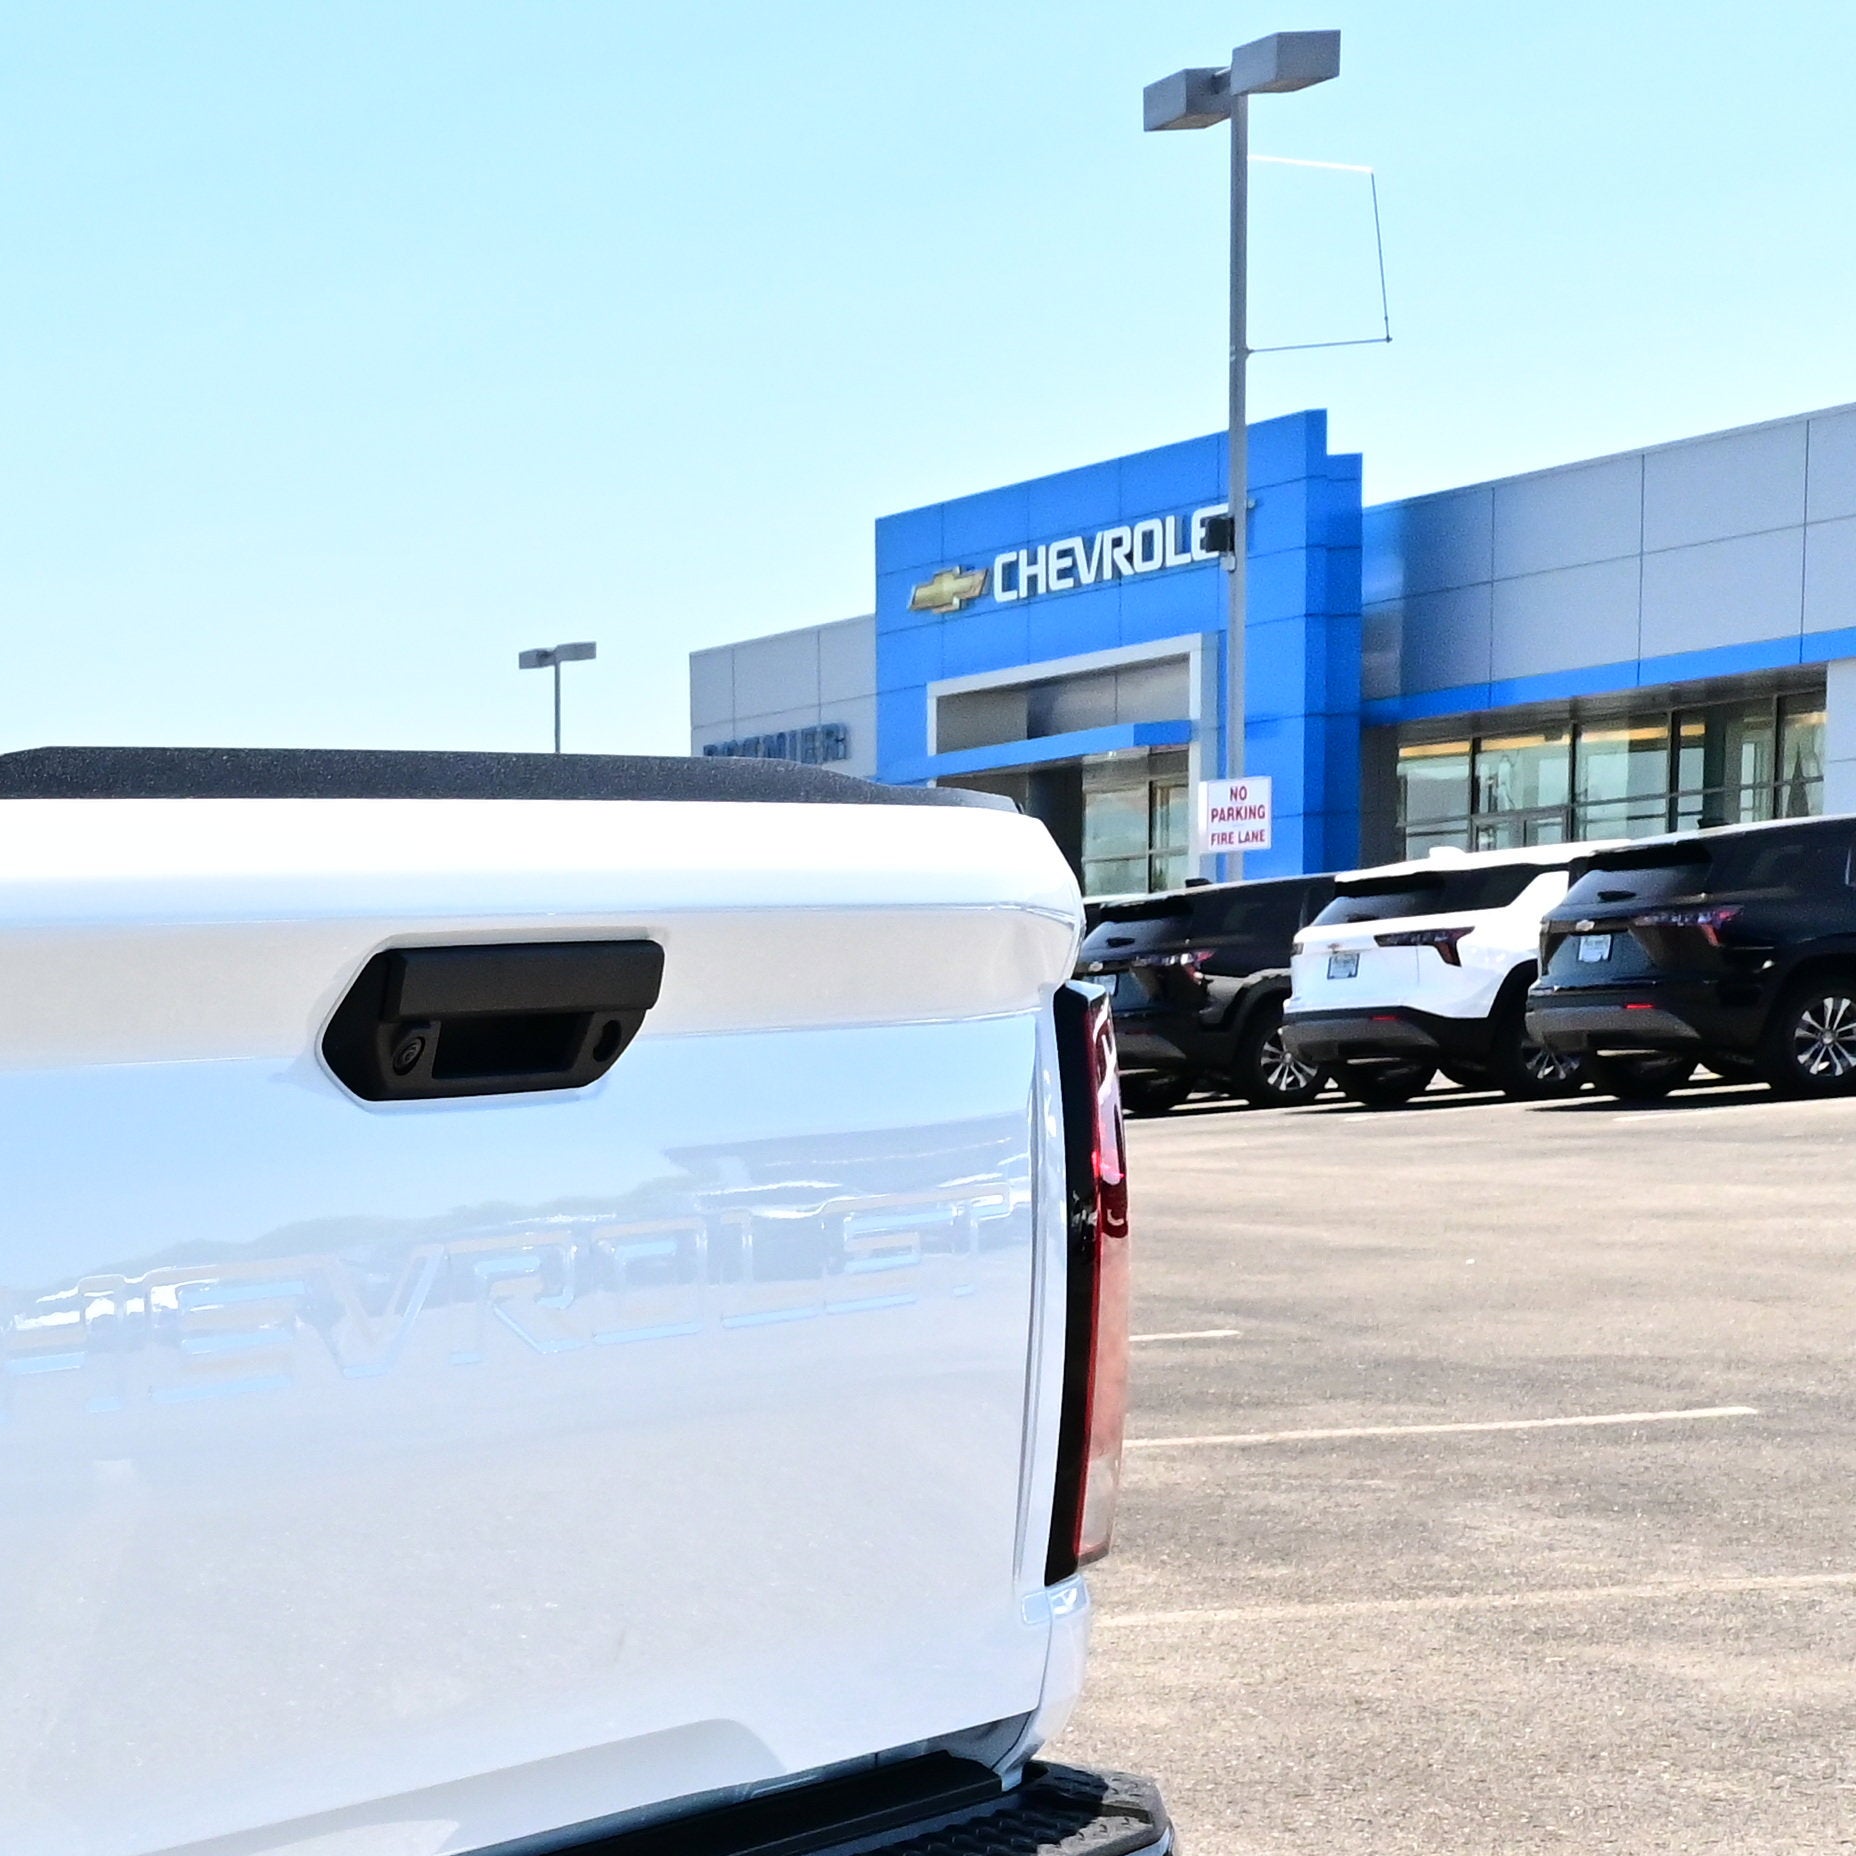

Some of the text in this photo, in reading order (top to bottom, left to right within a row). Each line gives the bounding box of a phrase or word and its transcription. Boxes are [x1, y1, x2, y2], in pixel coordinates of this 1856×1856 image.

[993, 504, 1229, 602] CHEVROLE
[1230, 785, 1247, 801] NO
[1211, 804, 1265, 823] PARKING
[1211, 829, 1265, 846] FIRE LANE
